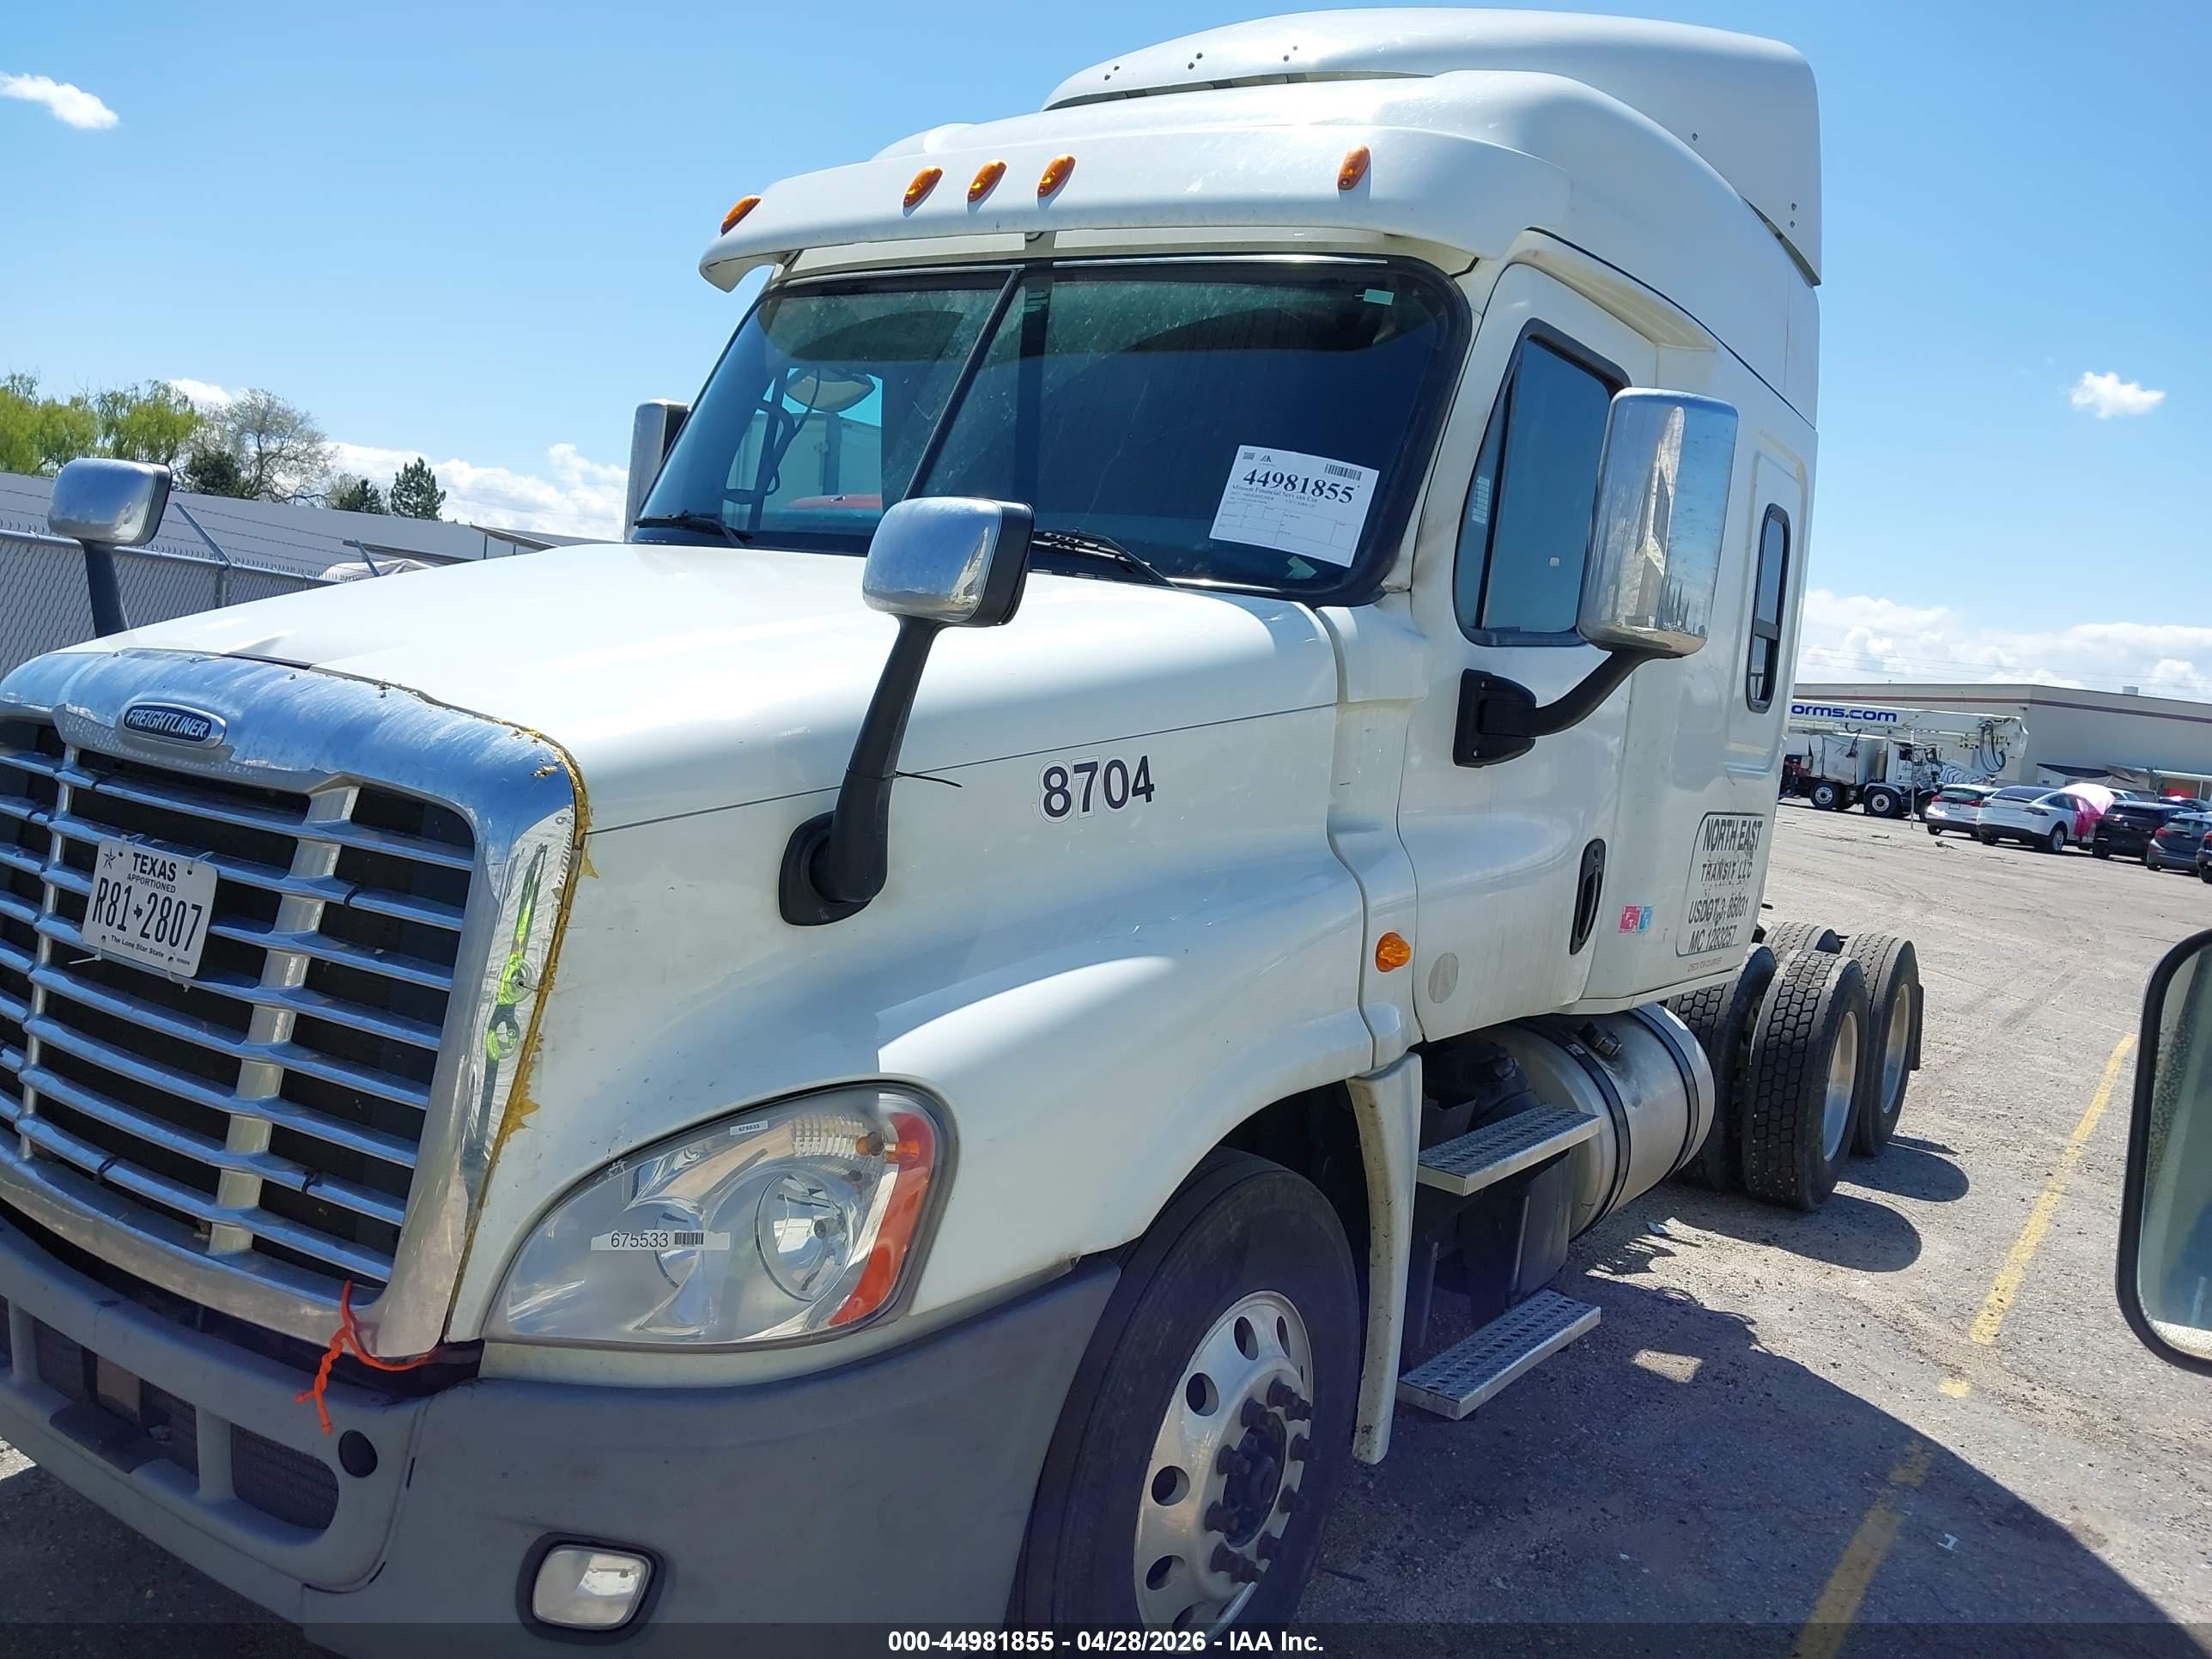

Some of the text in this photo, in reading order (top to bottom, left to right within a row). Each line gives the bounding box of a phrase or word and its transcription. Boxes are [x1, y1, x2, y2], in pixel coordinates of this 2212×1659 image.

[1243, 468, 1355, 504] 44981855
[126, 709, 210, 738] FREIGHTLINER
[1042, 756, 1155, 817] 8704
[1702, 817, 1763, 851] NORTH EAST
[132, 852, 177, 882] TEXAS
[1700, 860, 1753, 882] TRANSIT LLC
[126, 872, 176, 894] APPORTIONED
[92, 877, 204, 951] R81 2807
[111, 934, 165, 957] The Lone Star State
[1688, 928, 1705, 953] MC
[610, 1232, 669, 1248] 675533
